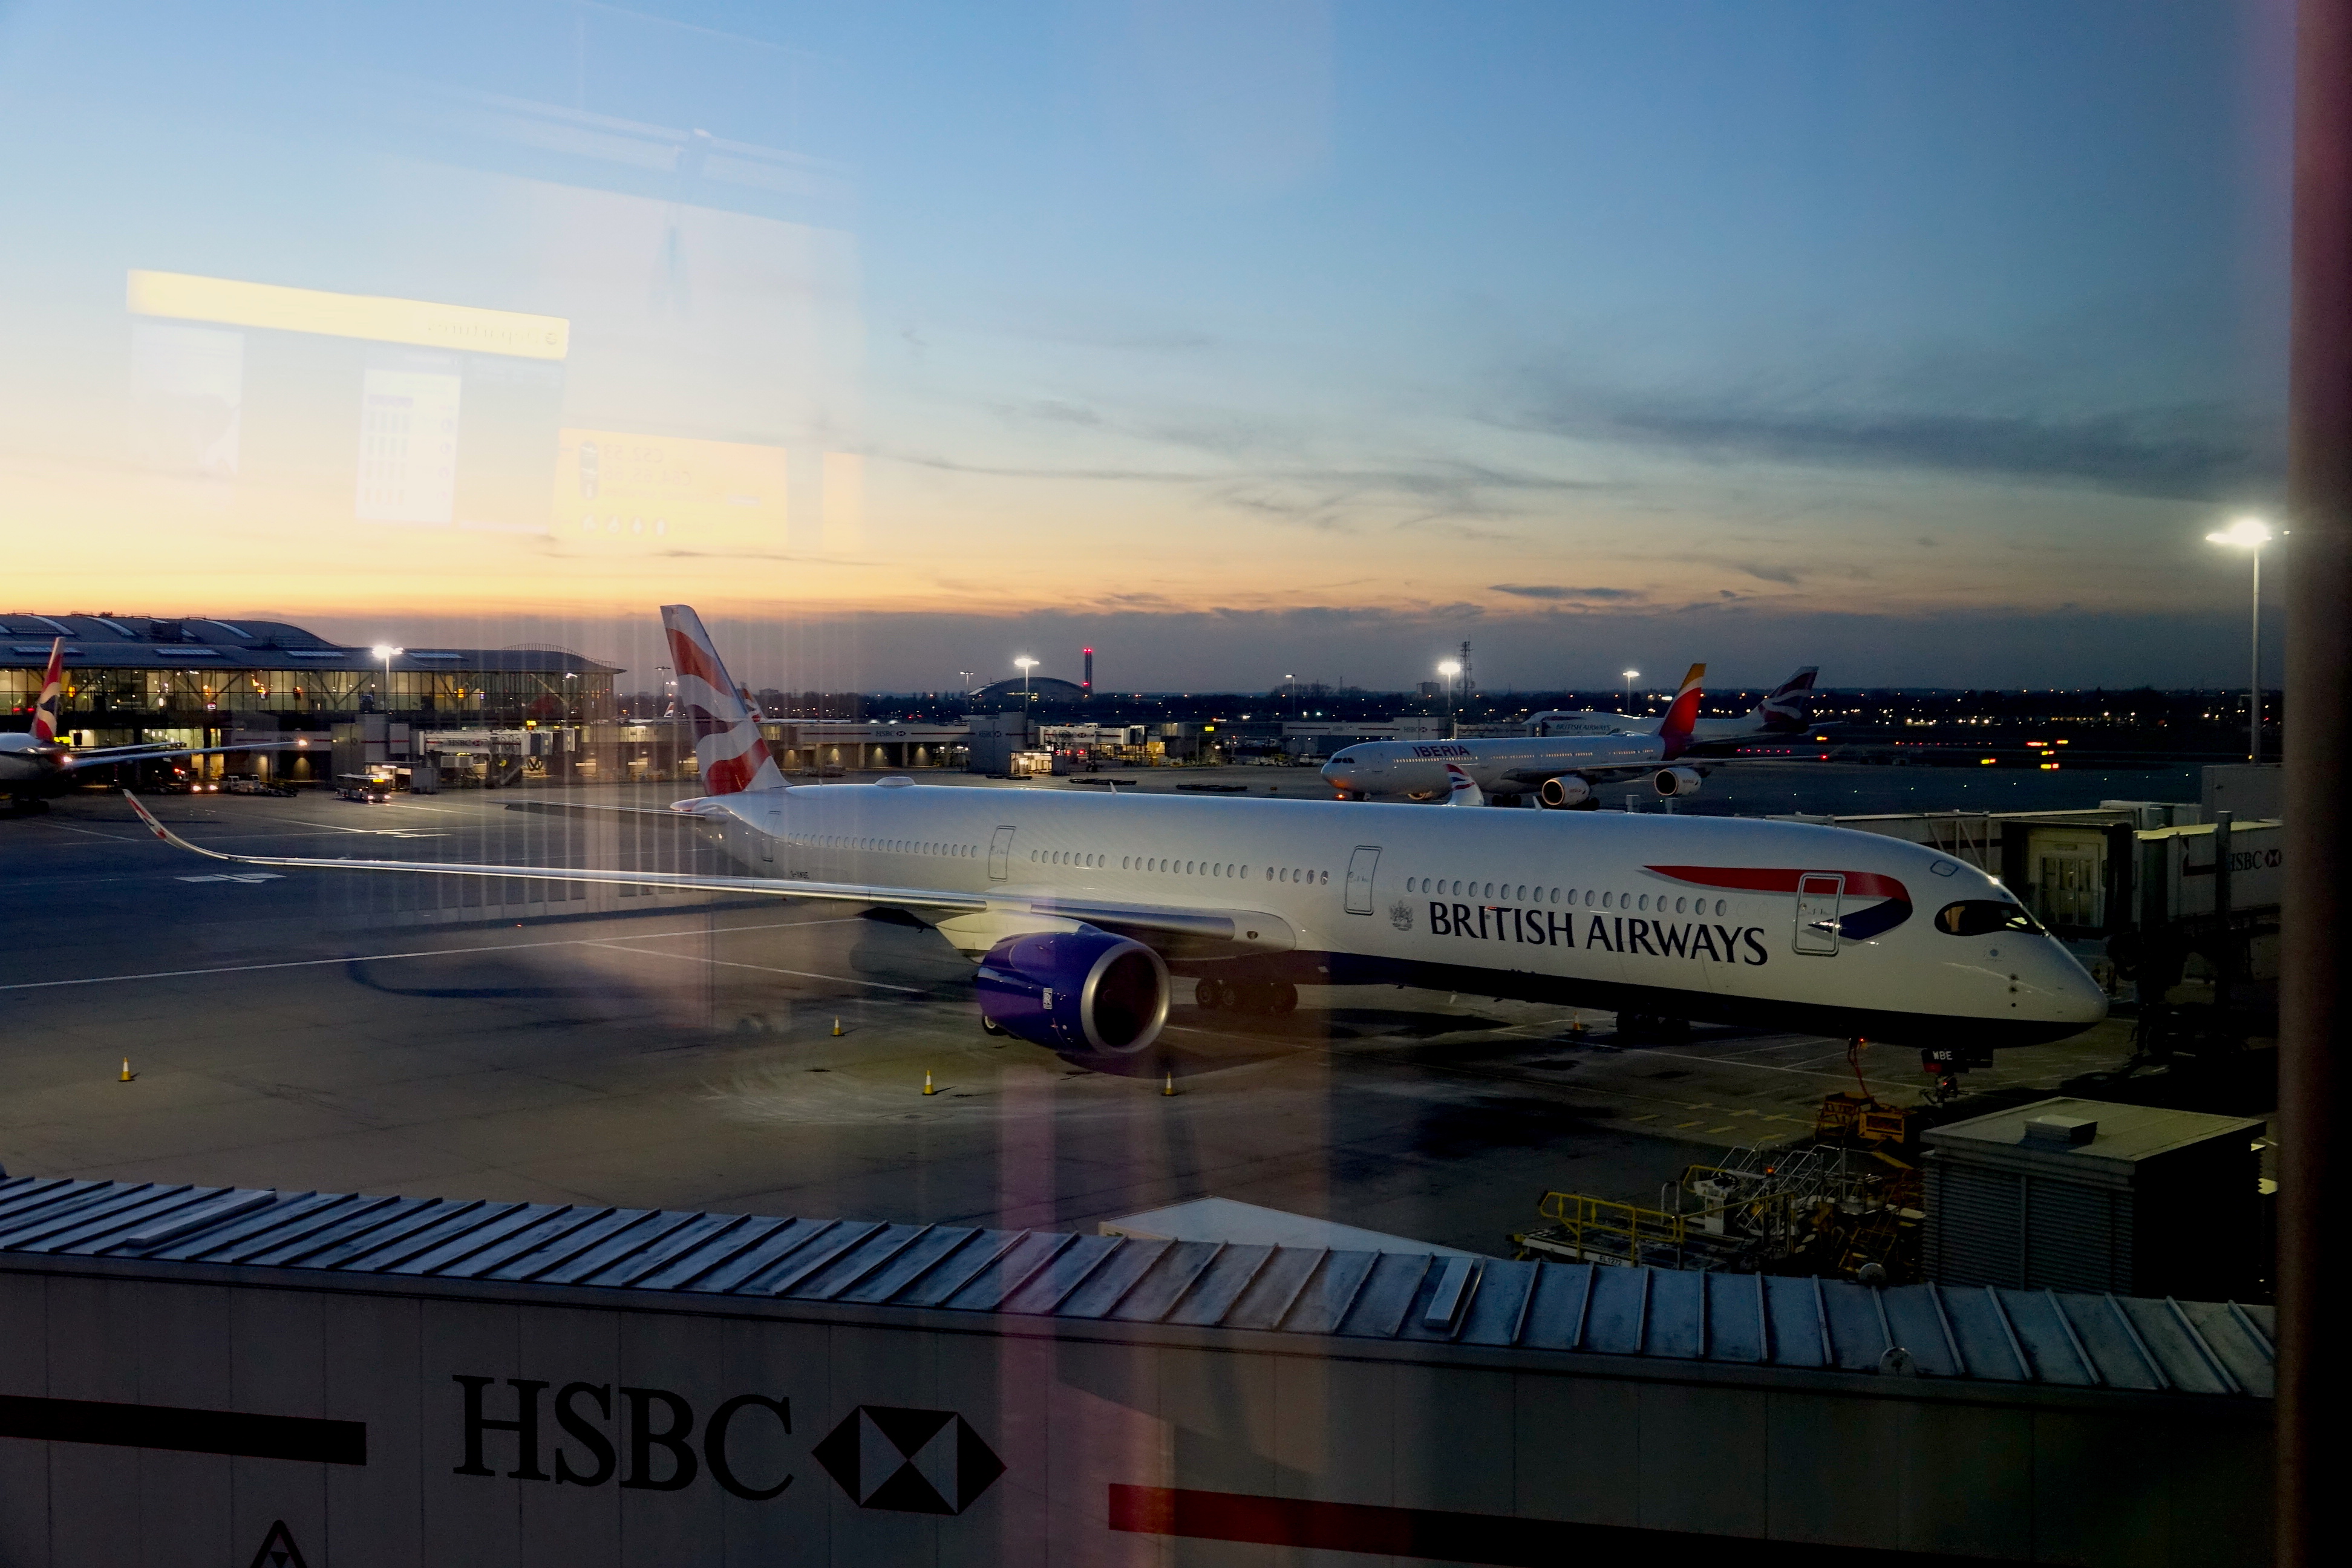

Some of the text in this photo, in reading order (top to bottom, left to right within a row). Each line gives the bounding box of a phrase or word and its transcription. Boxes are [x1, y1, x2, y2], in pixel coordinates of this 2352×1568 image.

[1412, 745, 1470, 757] IBERIA
[1429, 901, 1768, 966] BRITISH AIRWAYS
[1932, 1050, 1953, 1060] WBE
[452, 1374, 794, 1501] HSBC
